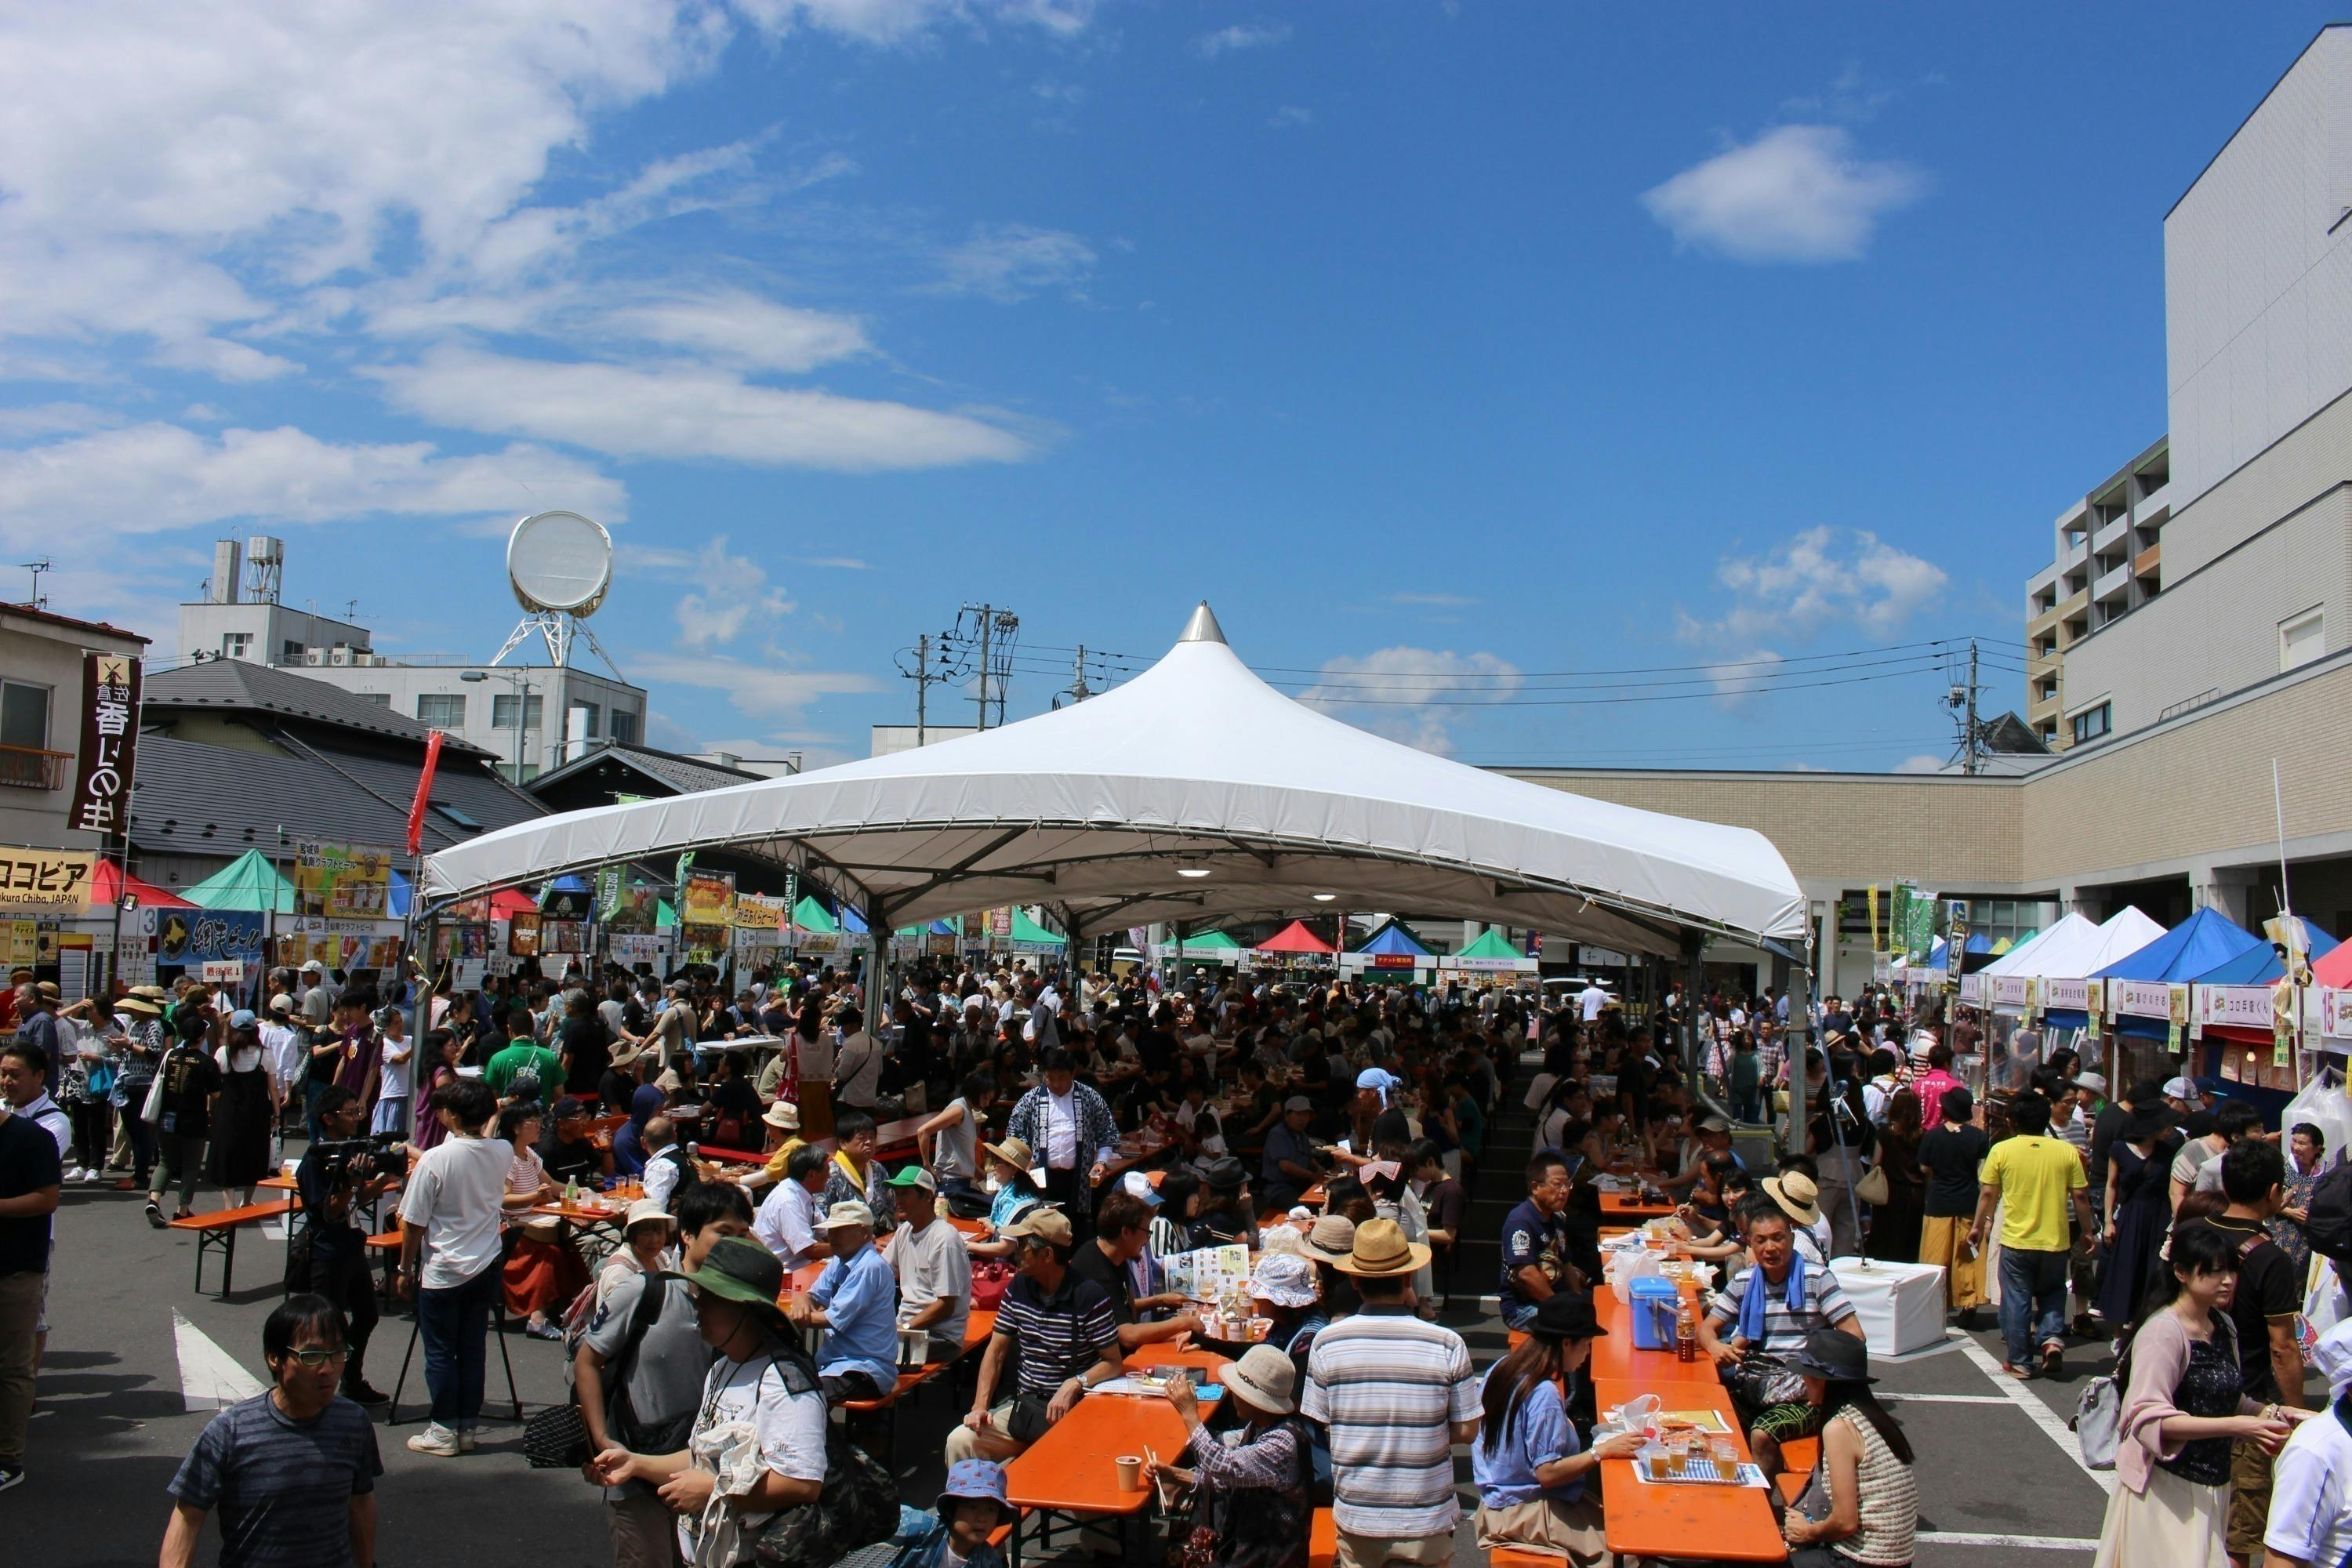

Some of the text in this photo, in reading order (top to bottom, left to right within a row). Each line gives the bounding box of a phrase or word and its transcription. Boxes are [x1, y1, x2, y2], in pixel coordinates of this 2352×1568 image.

[0, 892, 78, 905] kura Chiba, JAPAN
[602, 873, 618, 911] BREWING
[143, 908, 156, 934] 3
[294, 916, 305, 932] 4
[1159, 946, 1167, 956] 16
[1240, 949, 1248, 960] 17
[2202, 986, 2209, 1022] 14
[2322, 992, 2334, 1033] 15
